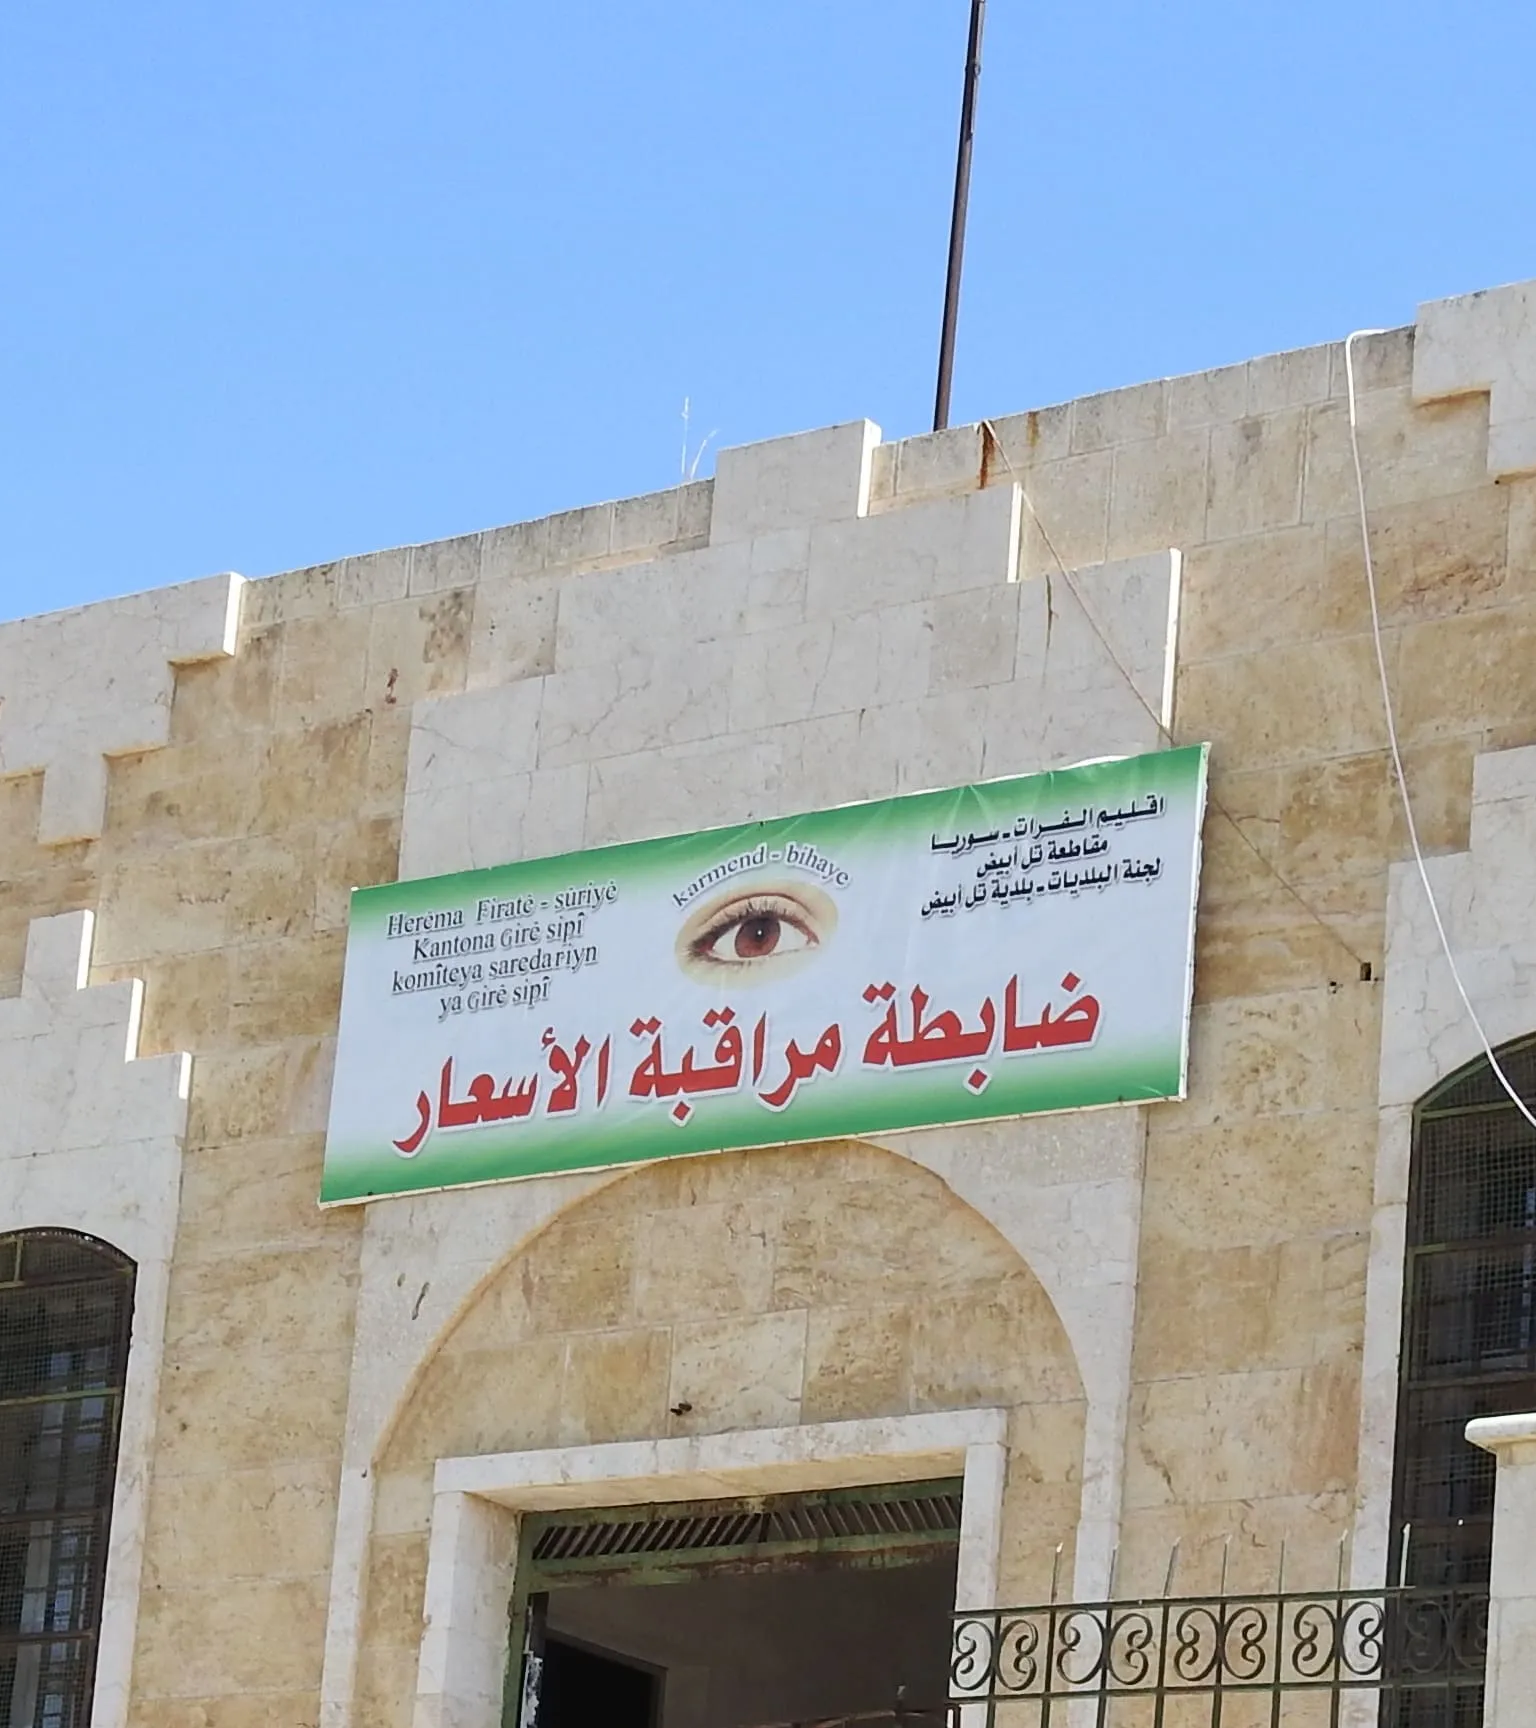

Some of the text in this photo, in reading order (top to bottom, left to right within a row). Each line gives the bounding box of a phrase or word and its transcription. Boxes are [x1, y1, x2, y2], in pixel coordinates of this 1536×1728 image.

[931, 826, 1000, 856] سوريا
[977, 833, 1109, 878] مقاطعة تل أبيض
[672, 846, 765, 907] karmend
[787, 844, 850, 886] bihaye
[1047, 866, 1119, 895] البلديات
[1122, 857, 1162, 883] لجنة
[921, 883, 963, 916] أبيض
[965, 881, 988, 908] تل
[991, 878, 1035, 904] بلدية
[413, 933, 496, 963] Kantona
[392, 962, 484, 994] komîteya
[438, 994, 463, 1021] ya
[393, 968, 1103, 1156] ضابطة مراقبة الأسعار
